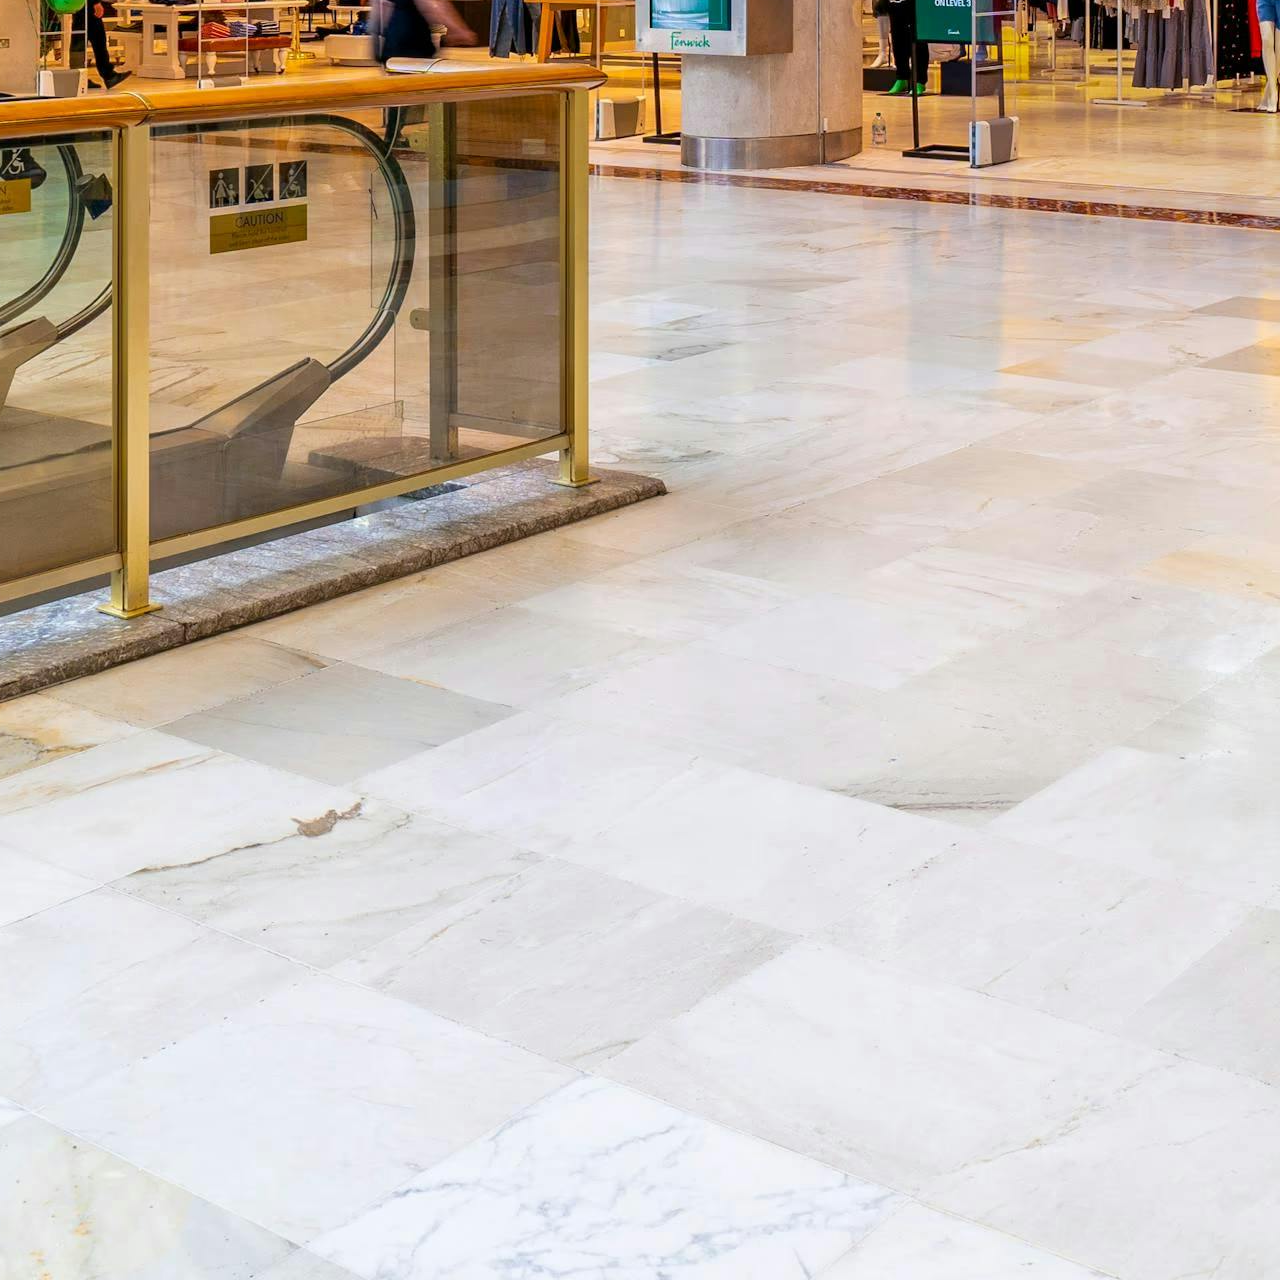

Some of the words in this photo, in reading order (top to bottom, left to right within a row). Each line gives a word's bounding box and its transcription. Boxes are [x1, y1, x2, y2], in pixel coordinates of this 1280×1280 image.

[935, 0, 945, 7] ON
[946, 0, 965, 7] LEVEL
[966, 0, 971, 7] 3
[671, 32, 710, 50] Fenwick
[235, 212, 283, 228] CAUTION
